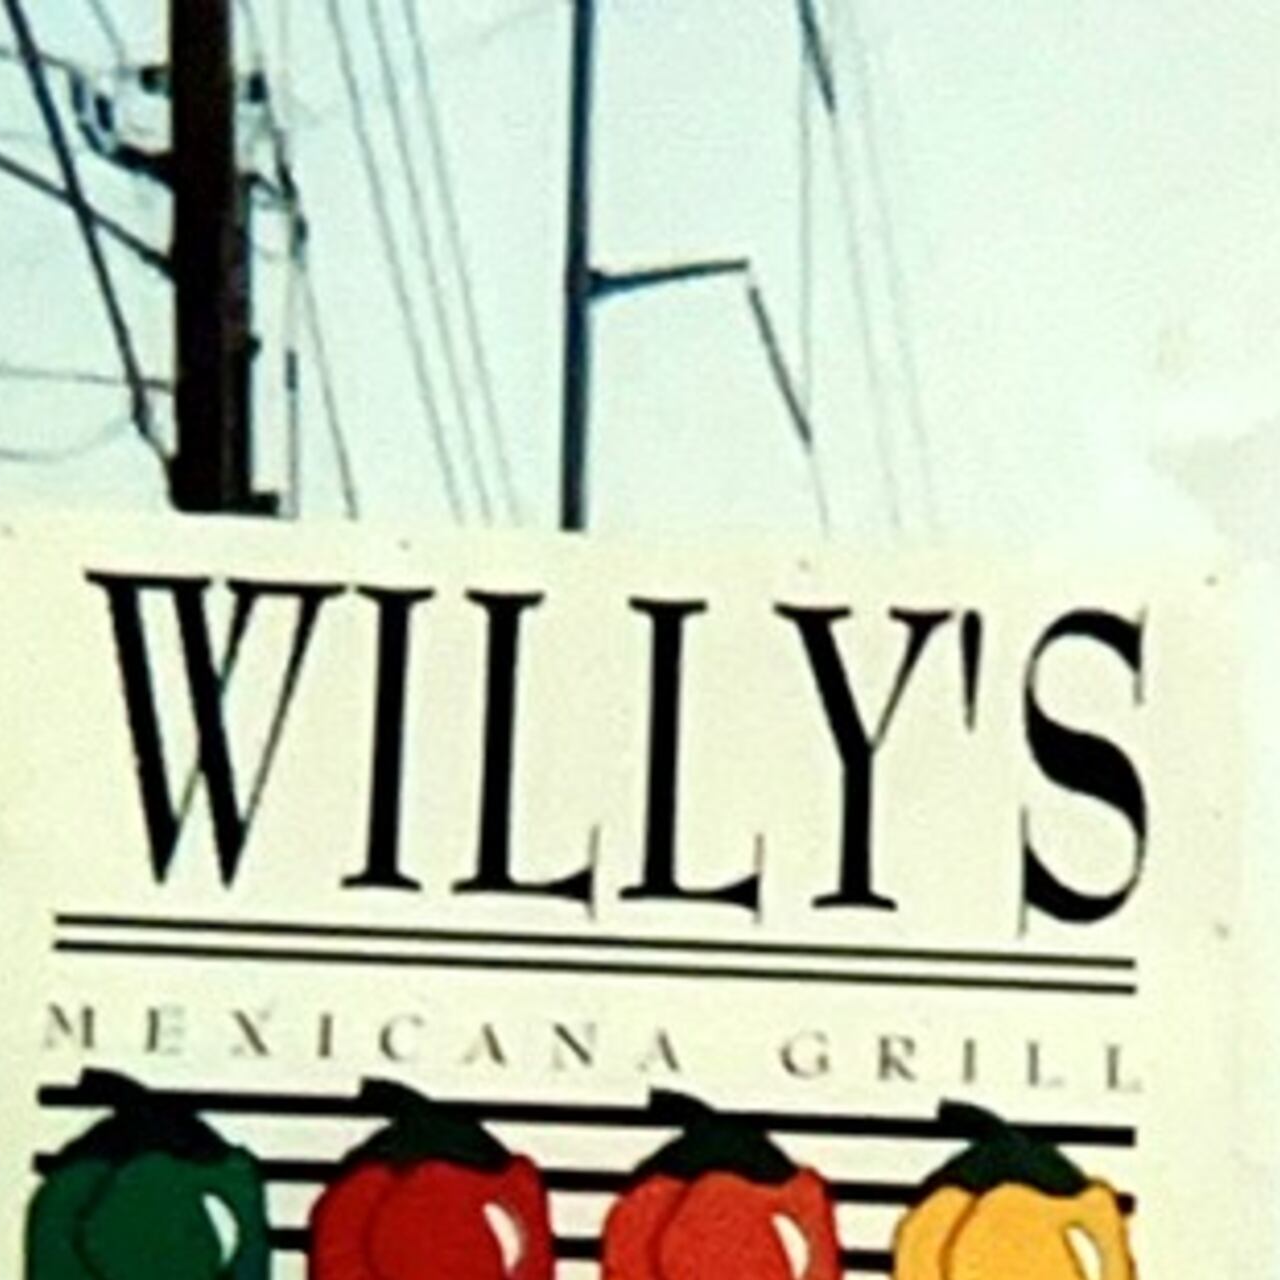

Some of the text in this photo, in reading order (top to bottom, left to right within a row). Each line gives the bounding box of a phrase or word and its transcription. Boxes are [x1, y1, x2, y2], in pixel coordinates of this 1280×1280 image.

[84, 567, 1150, 938] WILLY'S
[40, 1001, 1144, 1094] MEXICANA GRILL
